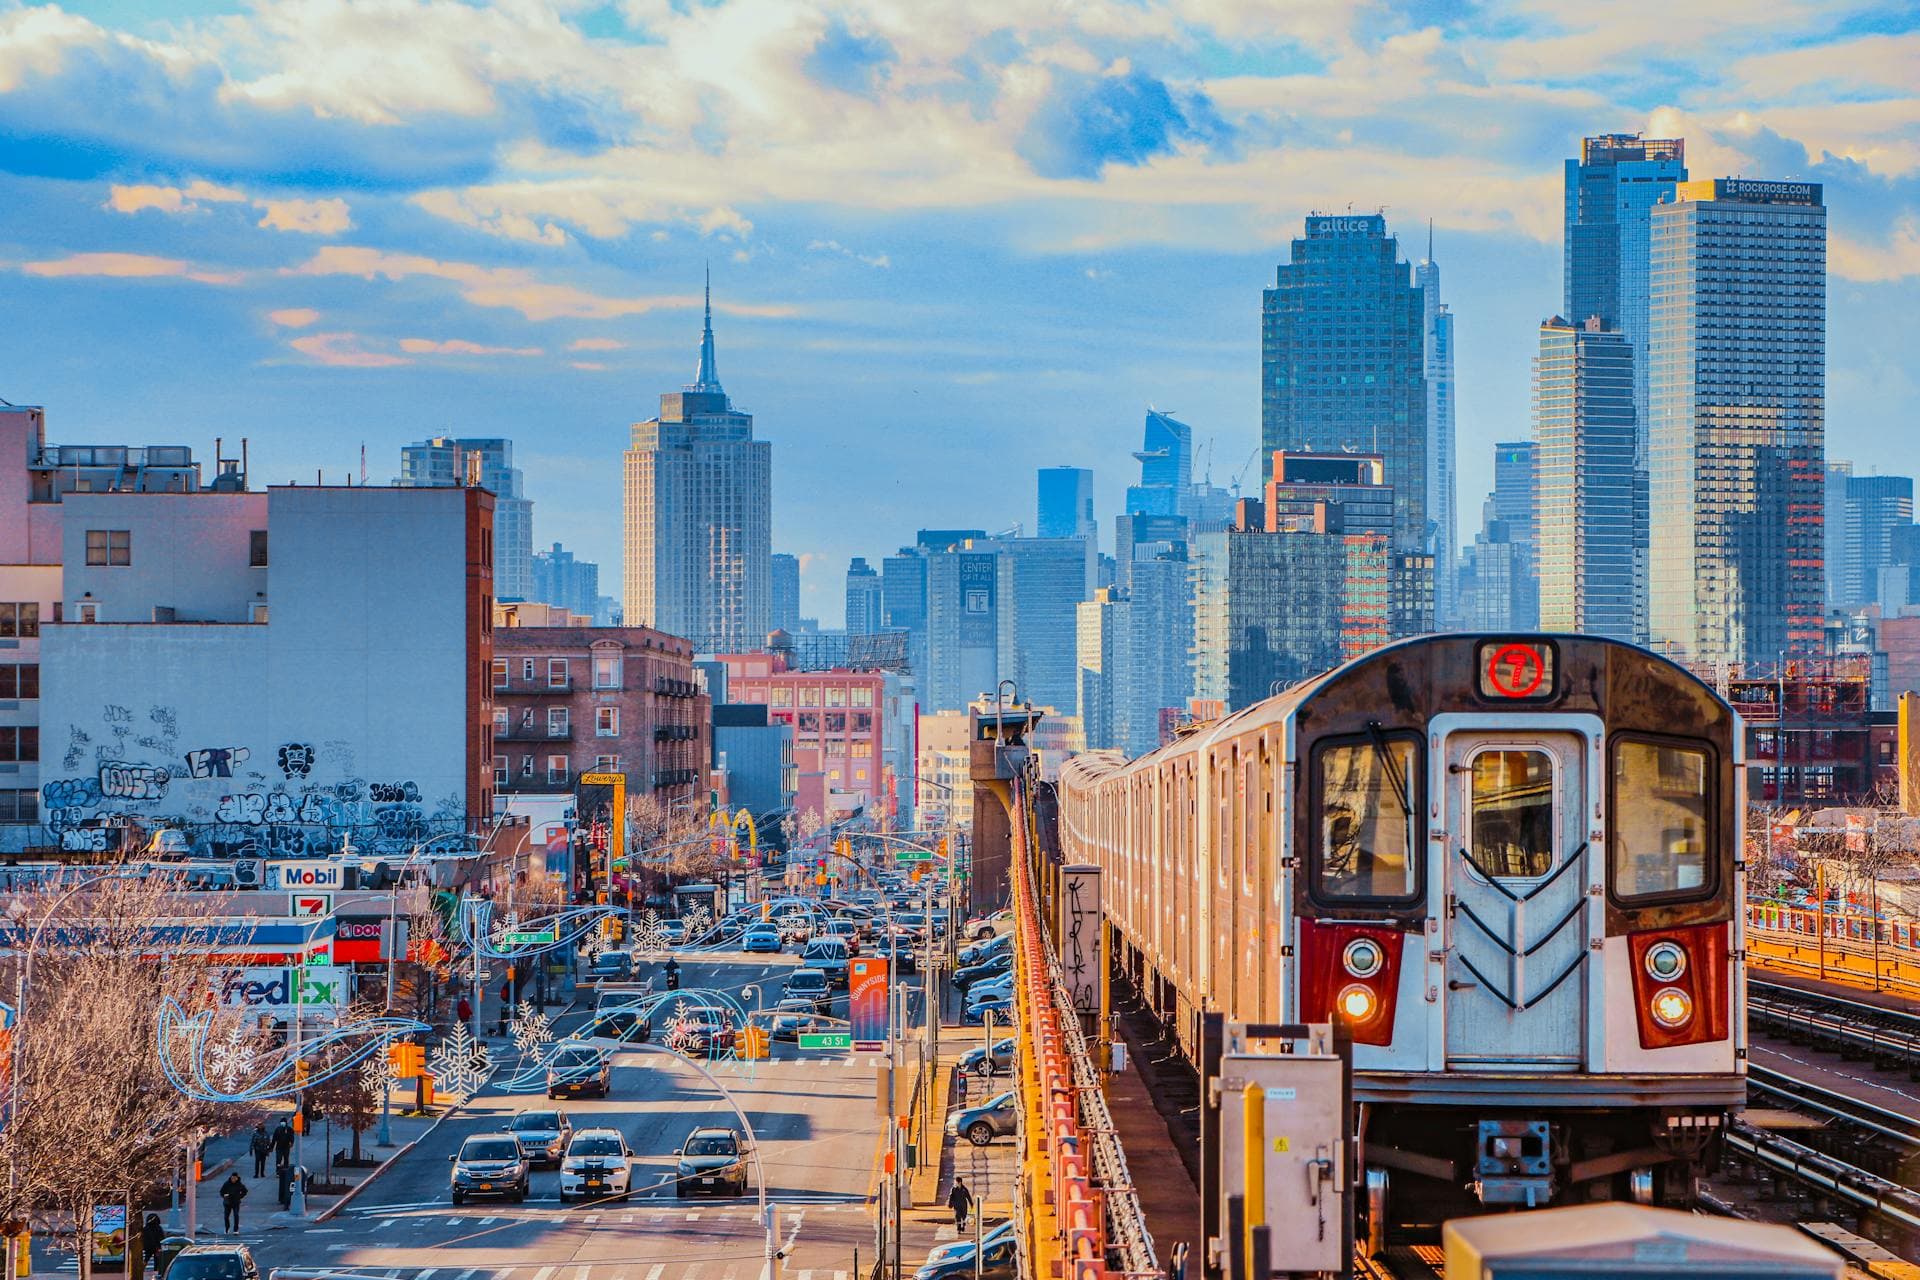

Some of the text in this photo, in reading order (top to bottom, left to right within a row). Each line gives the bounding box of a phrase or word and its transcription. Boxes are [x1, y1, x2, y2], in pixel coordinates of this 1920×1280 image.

[1738, 182, 1811, 195] ROCKROSE.COM
[1319, 217, 1369, 232] altice
[961, 562, 993, 573] CENTER
[583, 774, 623, 784] Lowery's
[286, 868, 337, 885] Mobil
[300, 900, 323, 914] 7
[850, 974, 887, 1001] SUNNYSIDE
[822, 1037, 844, 1045] 43 St
